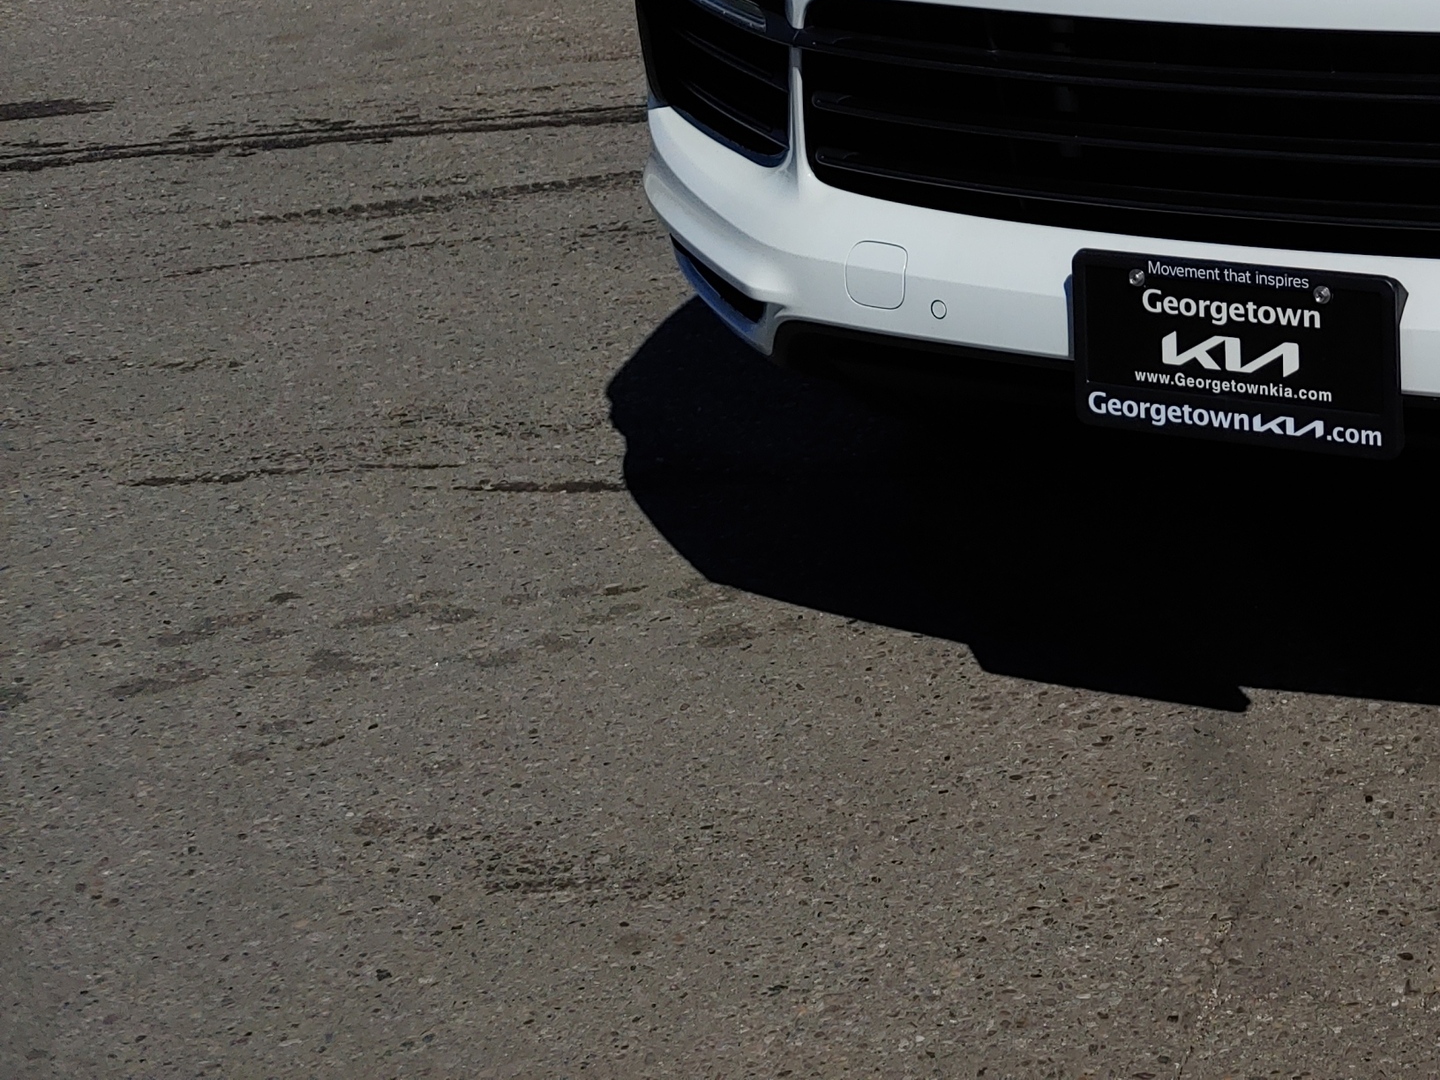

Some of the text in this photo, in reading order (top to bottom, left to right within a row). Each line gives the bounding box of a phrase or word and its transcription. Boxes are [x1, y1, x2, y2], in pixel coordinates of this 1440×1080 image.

[1147, 260, 1309, 288] Movement that inspires
[1142, 288, 1321, 328] Georgetown
[1161, 331, 1300, 378] KIA
[1134, 370, 1333, 402] www.Georgetownkia.com
